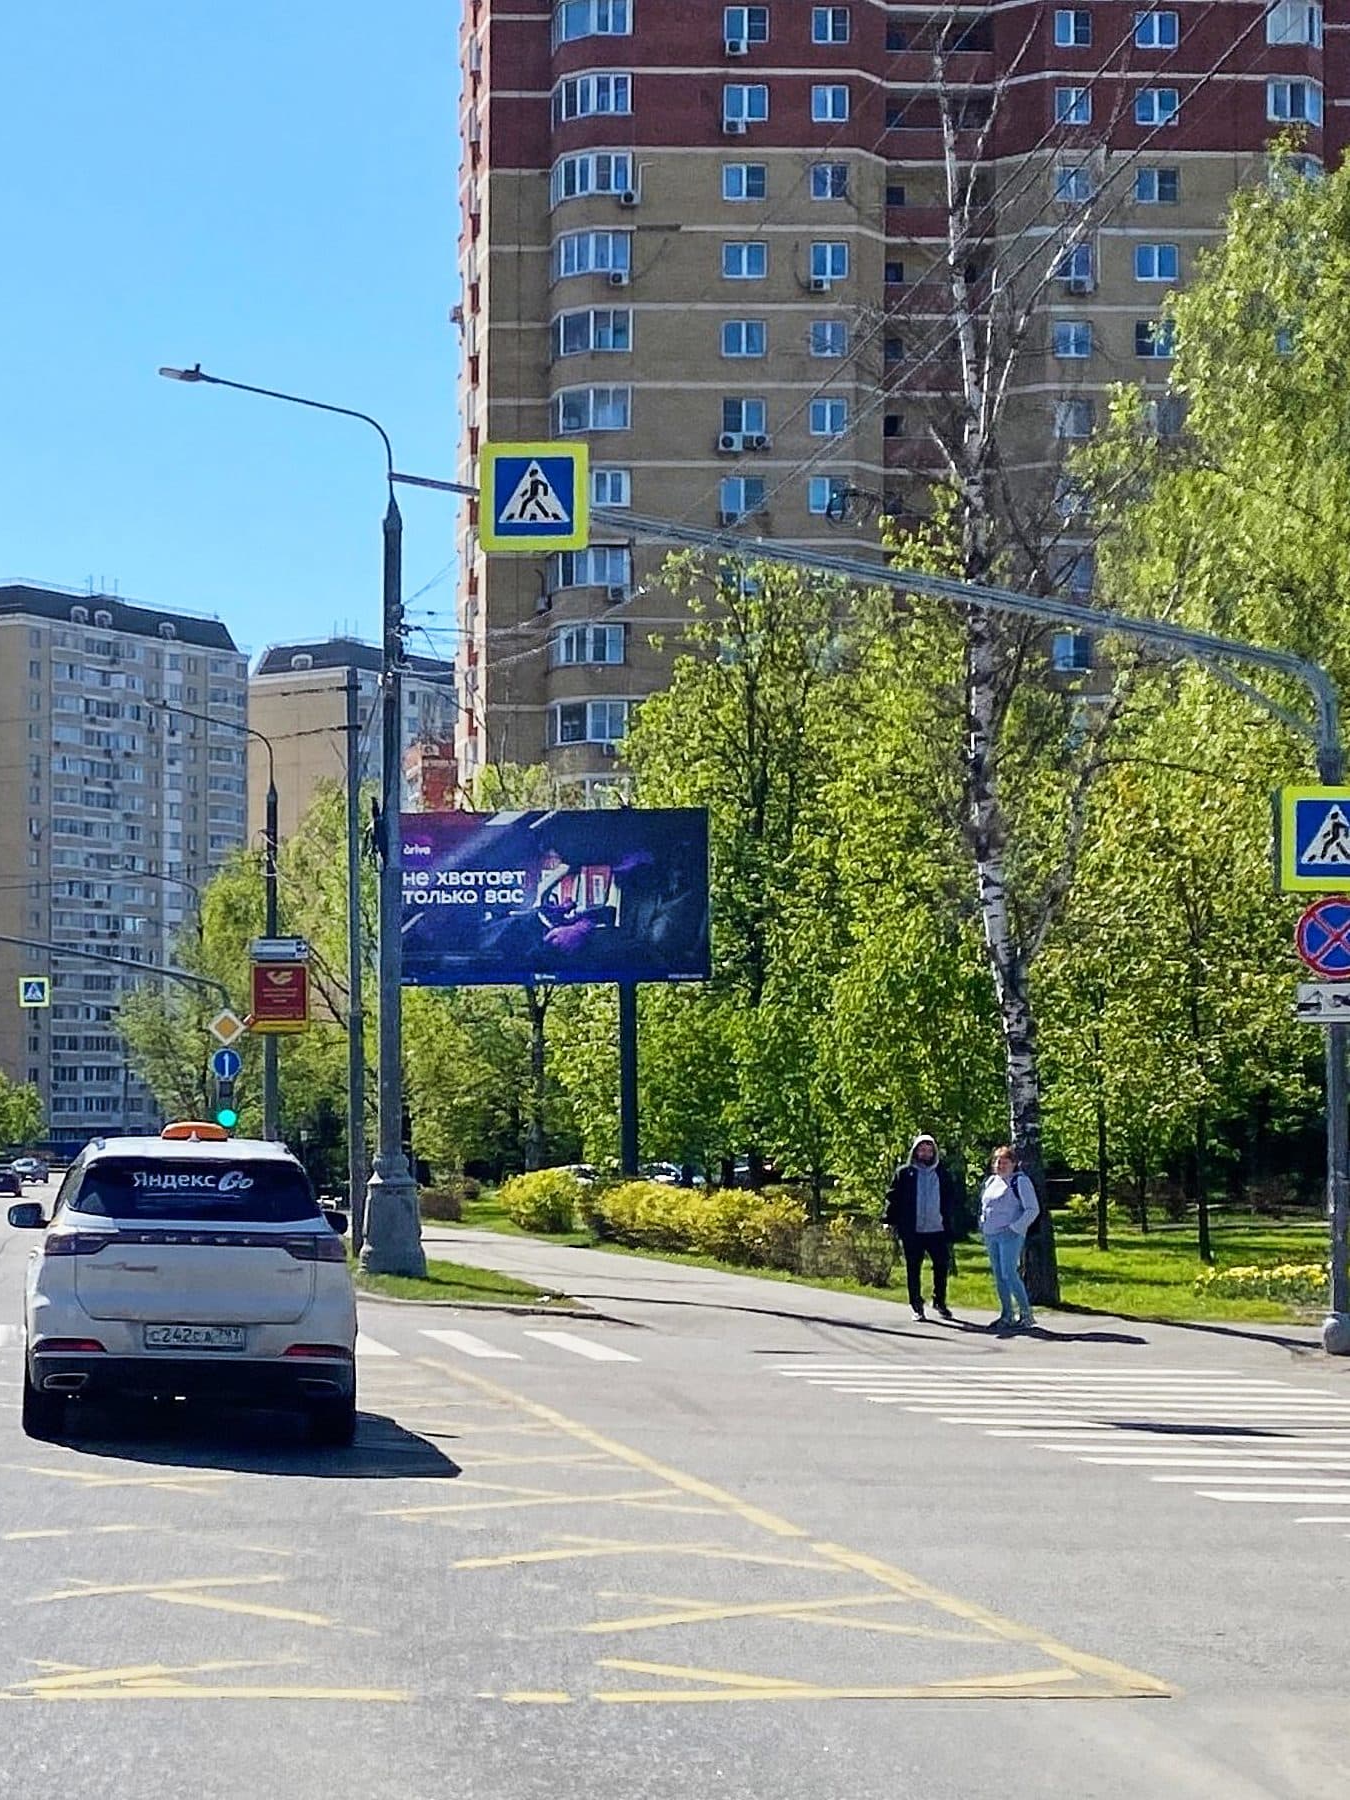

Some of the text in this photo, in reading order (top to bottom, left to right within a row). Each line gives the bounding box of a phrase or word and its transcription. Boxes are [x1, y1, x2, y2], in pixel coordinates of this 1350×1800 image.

[402, 871, 526, 886] не хватает
[402, 889, 525, 904] только вас
[133, 1171, 254, 1191] Яндекс Go
